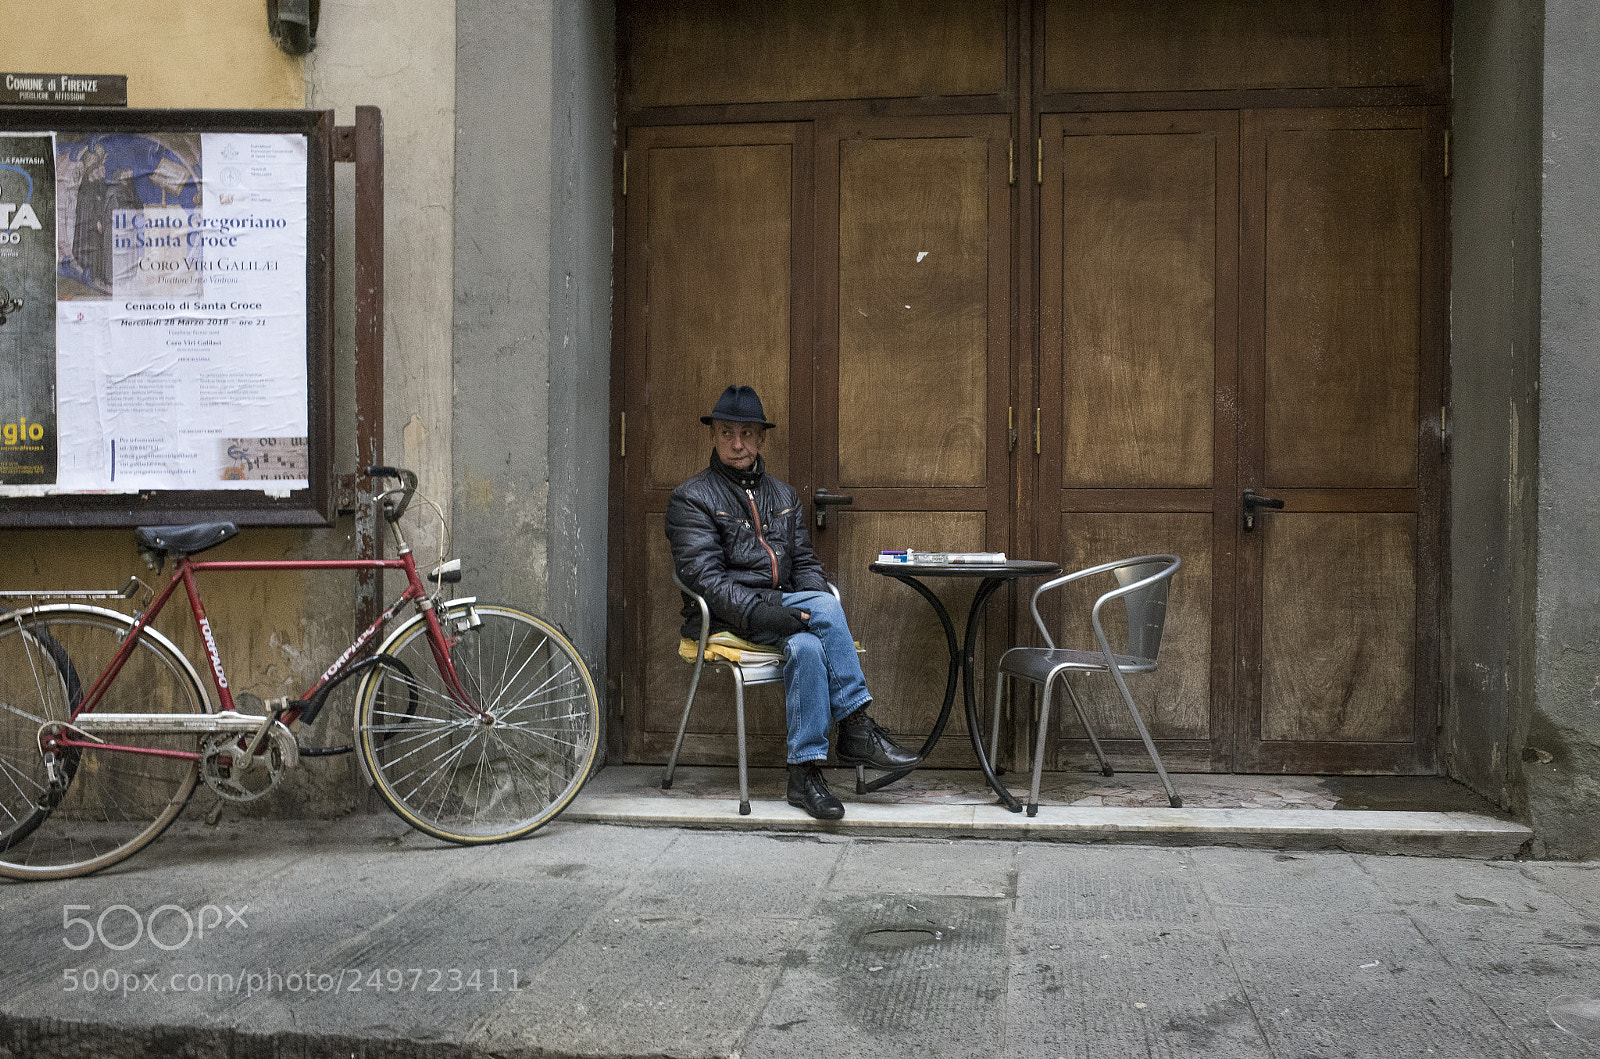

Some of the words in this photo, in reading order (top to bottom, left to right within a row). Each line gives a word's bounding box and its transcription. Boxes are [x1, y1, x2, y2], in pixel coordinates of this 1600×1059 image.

[6, 74, 44, 91] COMUNE
[48, 79, 56, 91] di
[61, 76, 98, 92] FIRENZE
[11, 157, 45, 165] FANTASIA
[115, 213, 127, 229] Il
[132, 213, 183, 229] Canto
[188, 213, 287, 234] Gregoriano
[115, 233, 131, 248] in
[136, 232, 181, 248] Santa
[187, 231, 238, 247] Croce
[139, 257, 180, 271] CORO
[184, 257, 213, 271] VIRI
[125, 301, 176, 311] Cenacolo
[179, 301, 190, 311] di
[194, 301, 226, 311] Santa
[230, 301, 263, 310] Croce
[164, 318, 175, 326] 28
[177, 318, 204, 326] Marzo
[207, 318, 229, 326] 2018
[199, 616, 228, 688] TORPADO
